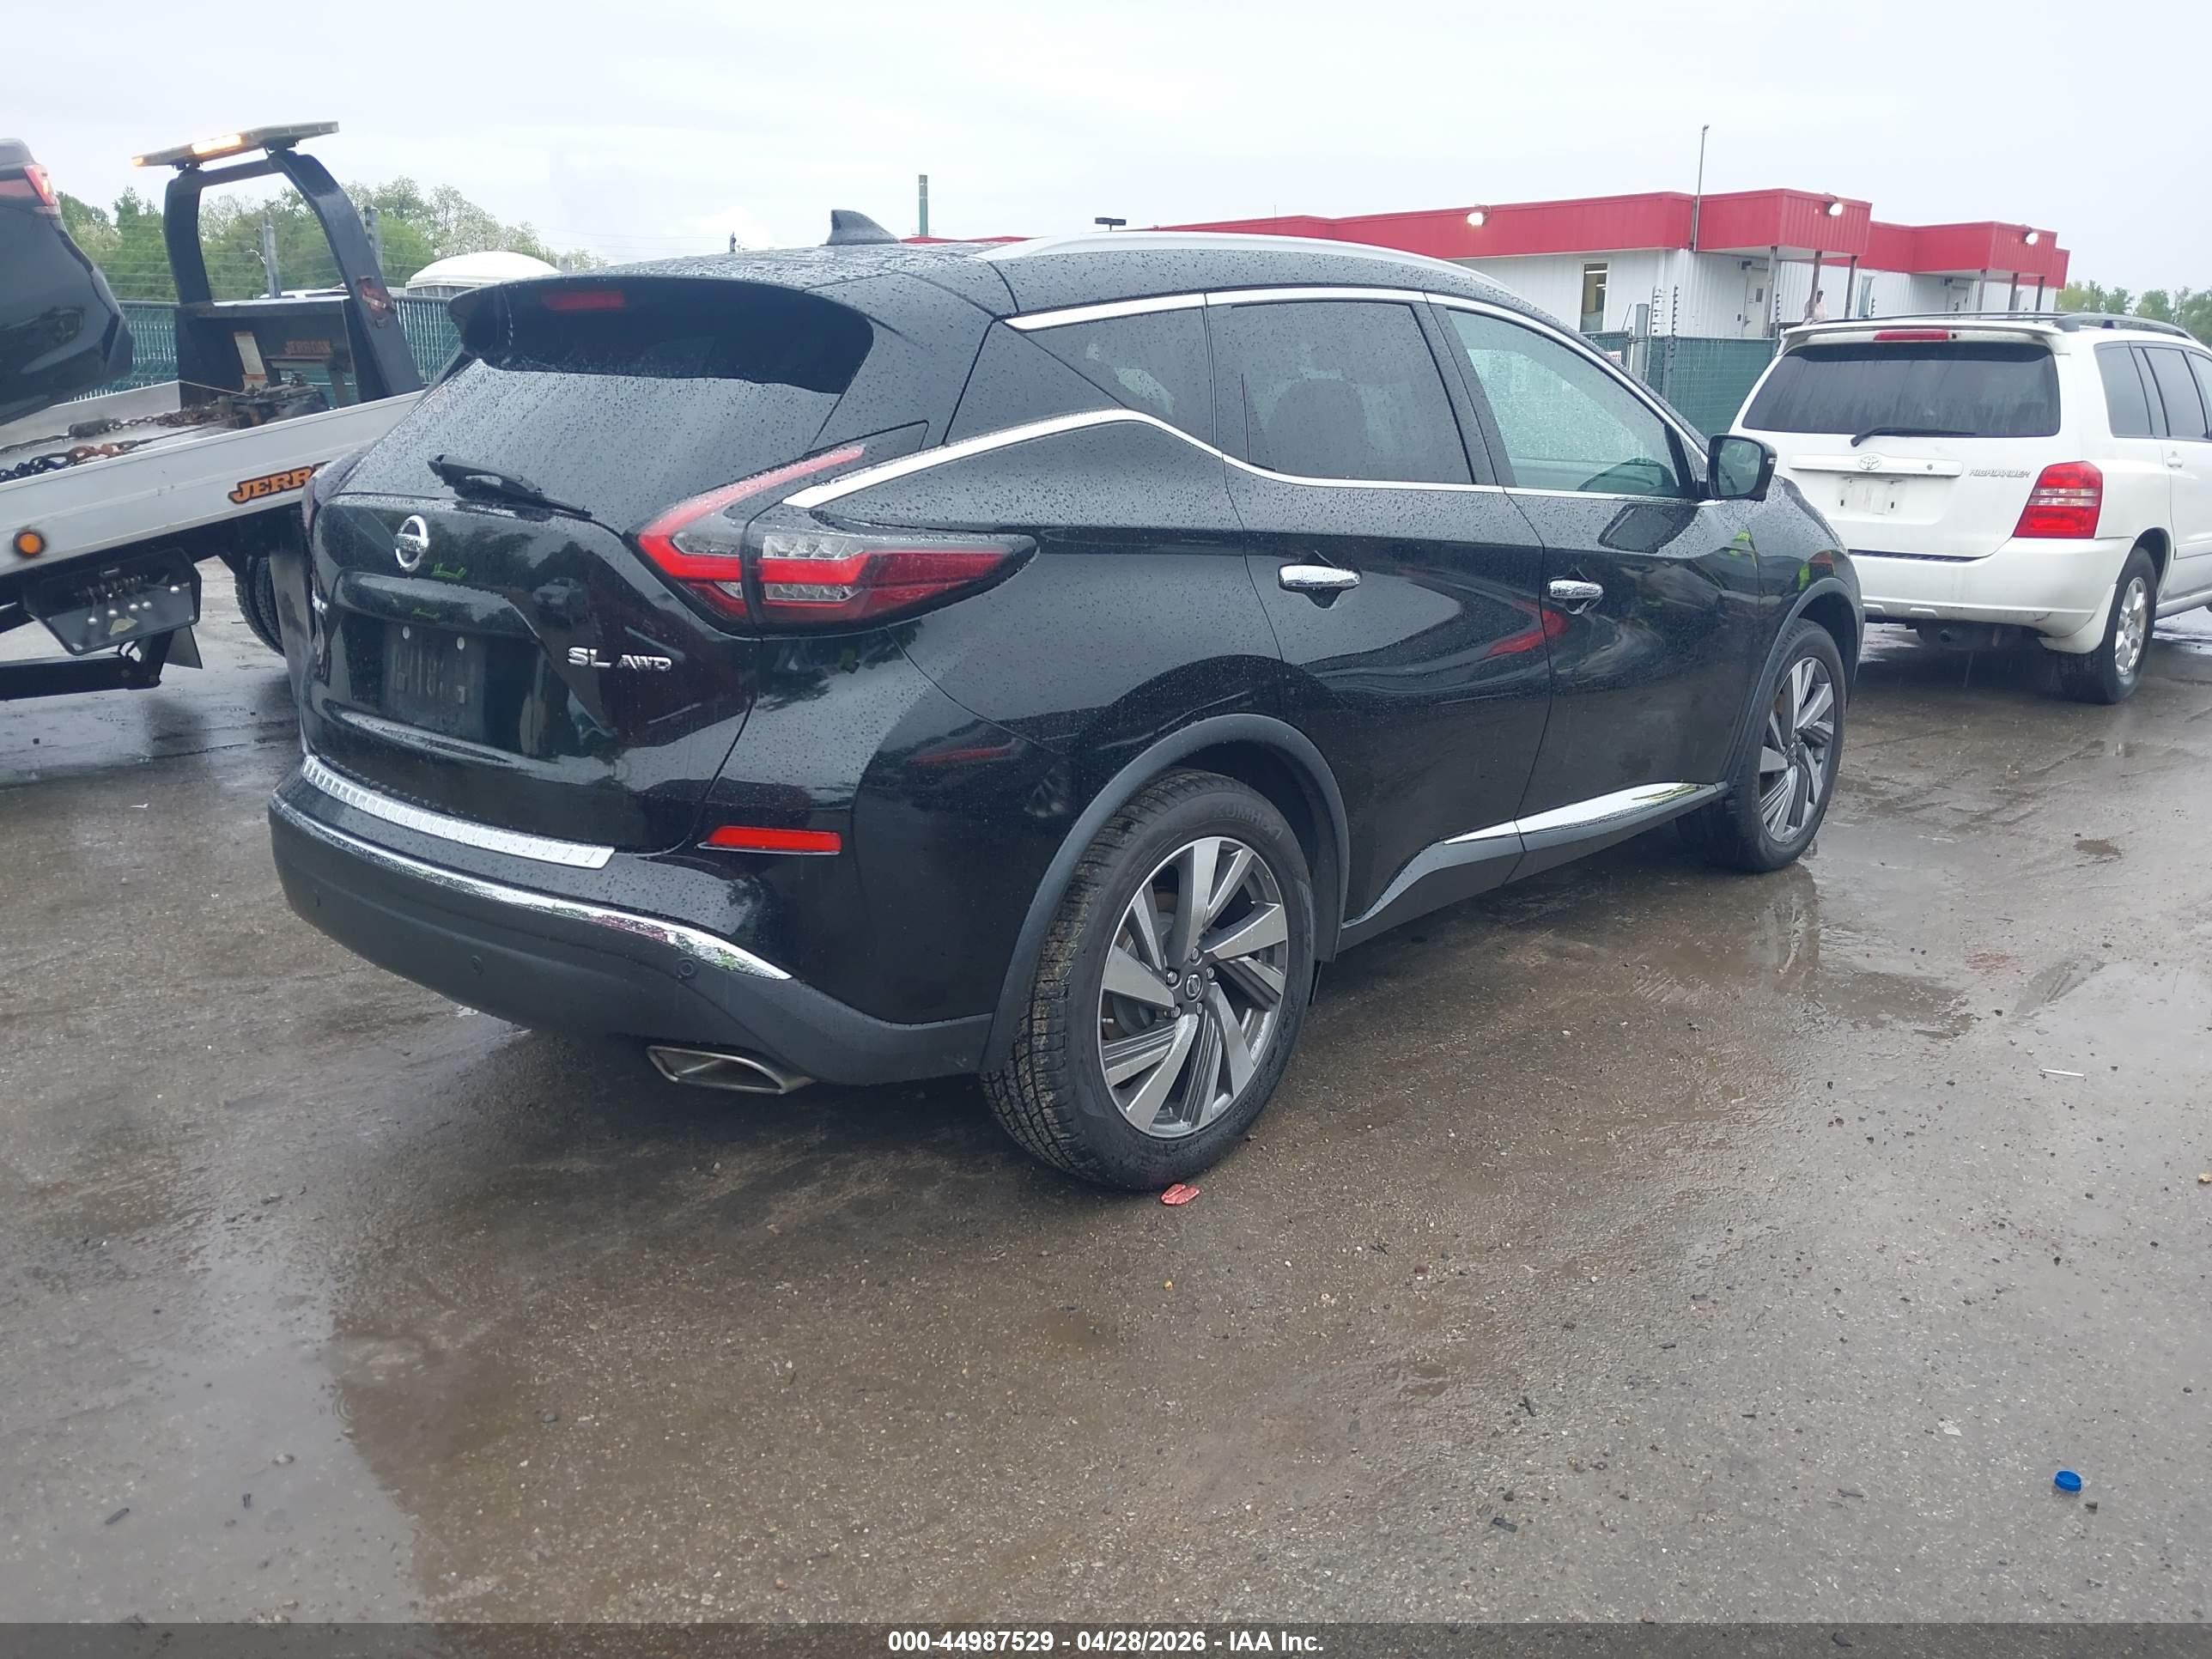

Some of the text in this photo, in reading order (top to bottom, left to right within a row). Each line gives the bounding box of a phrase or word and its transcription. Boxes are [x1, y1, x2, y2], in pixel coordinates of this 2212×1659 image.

[228, 464, 314, 504] JERR
[568, 647, 672, 671] SL AWD
